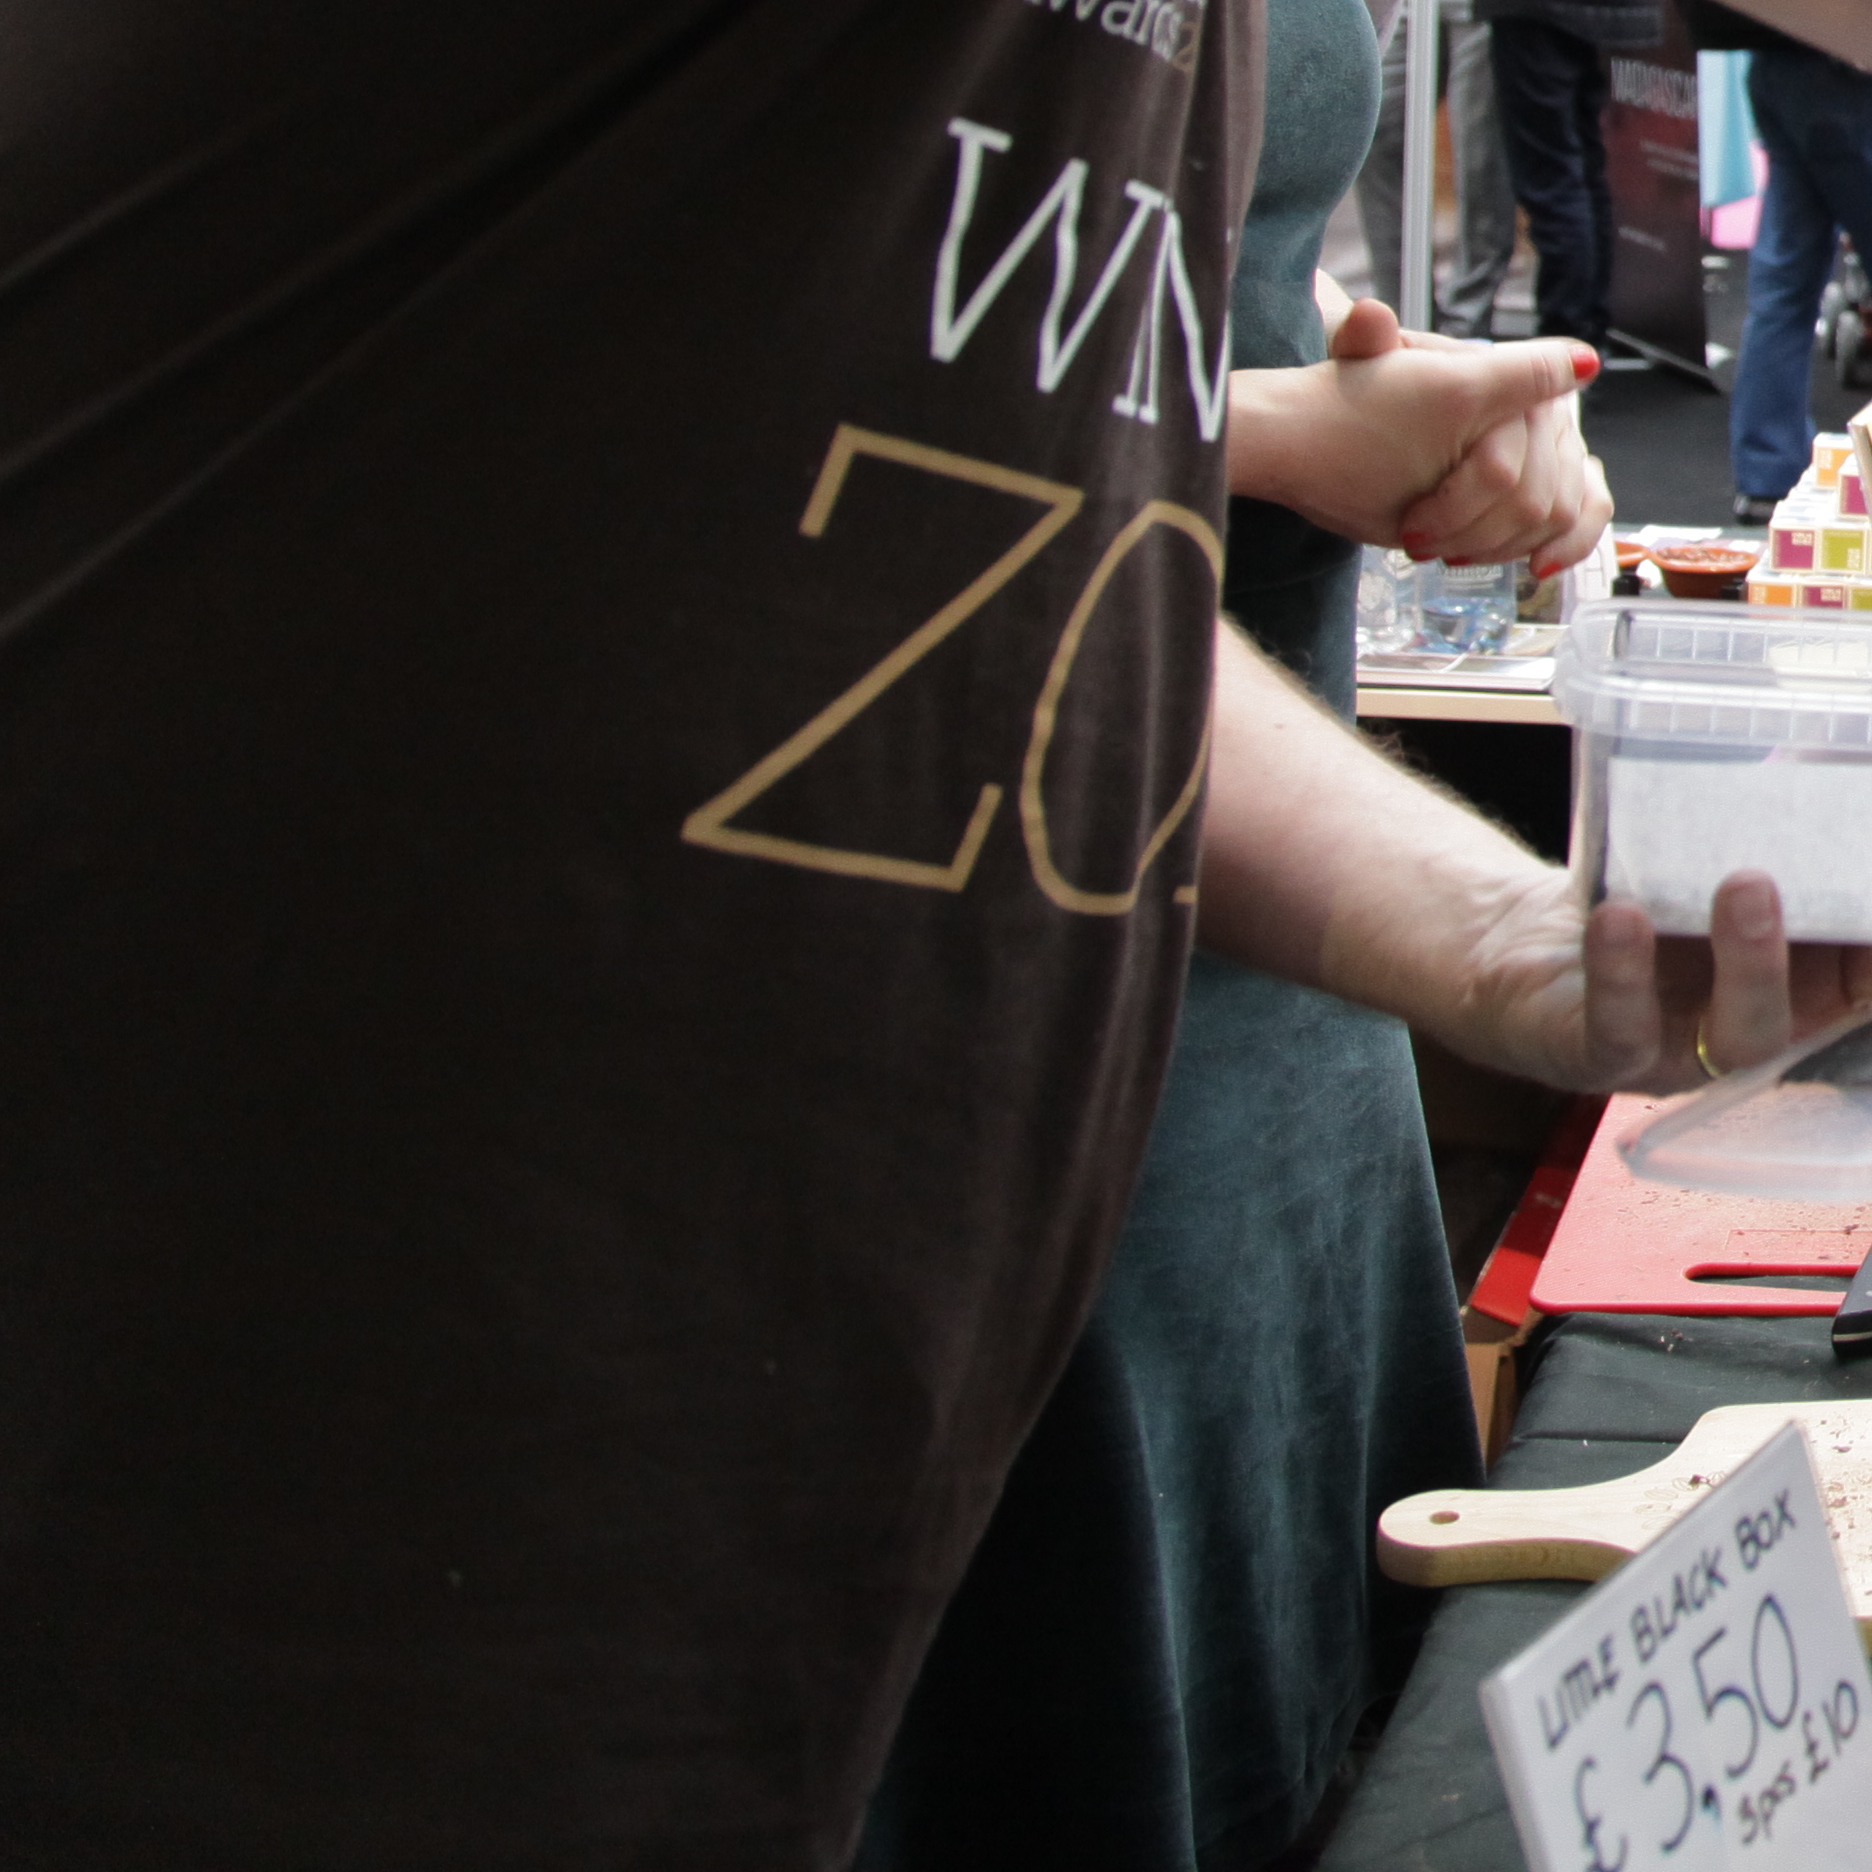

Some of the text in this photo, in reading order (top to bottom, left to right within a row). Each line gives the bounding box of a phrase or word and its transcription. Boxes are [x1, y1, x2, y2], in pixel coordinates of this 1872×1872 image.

[1535, 1488, 1798, 1753] LITTLE BLACK BOX
[1801, 1679, 1860, 1786] £10
